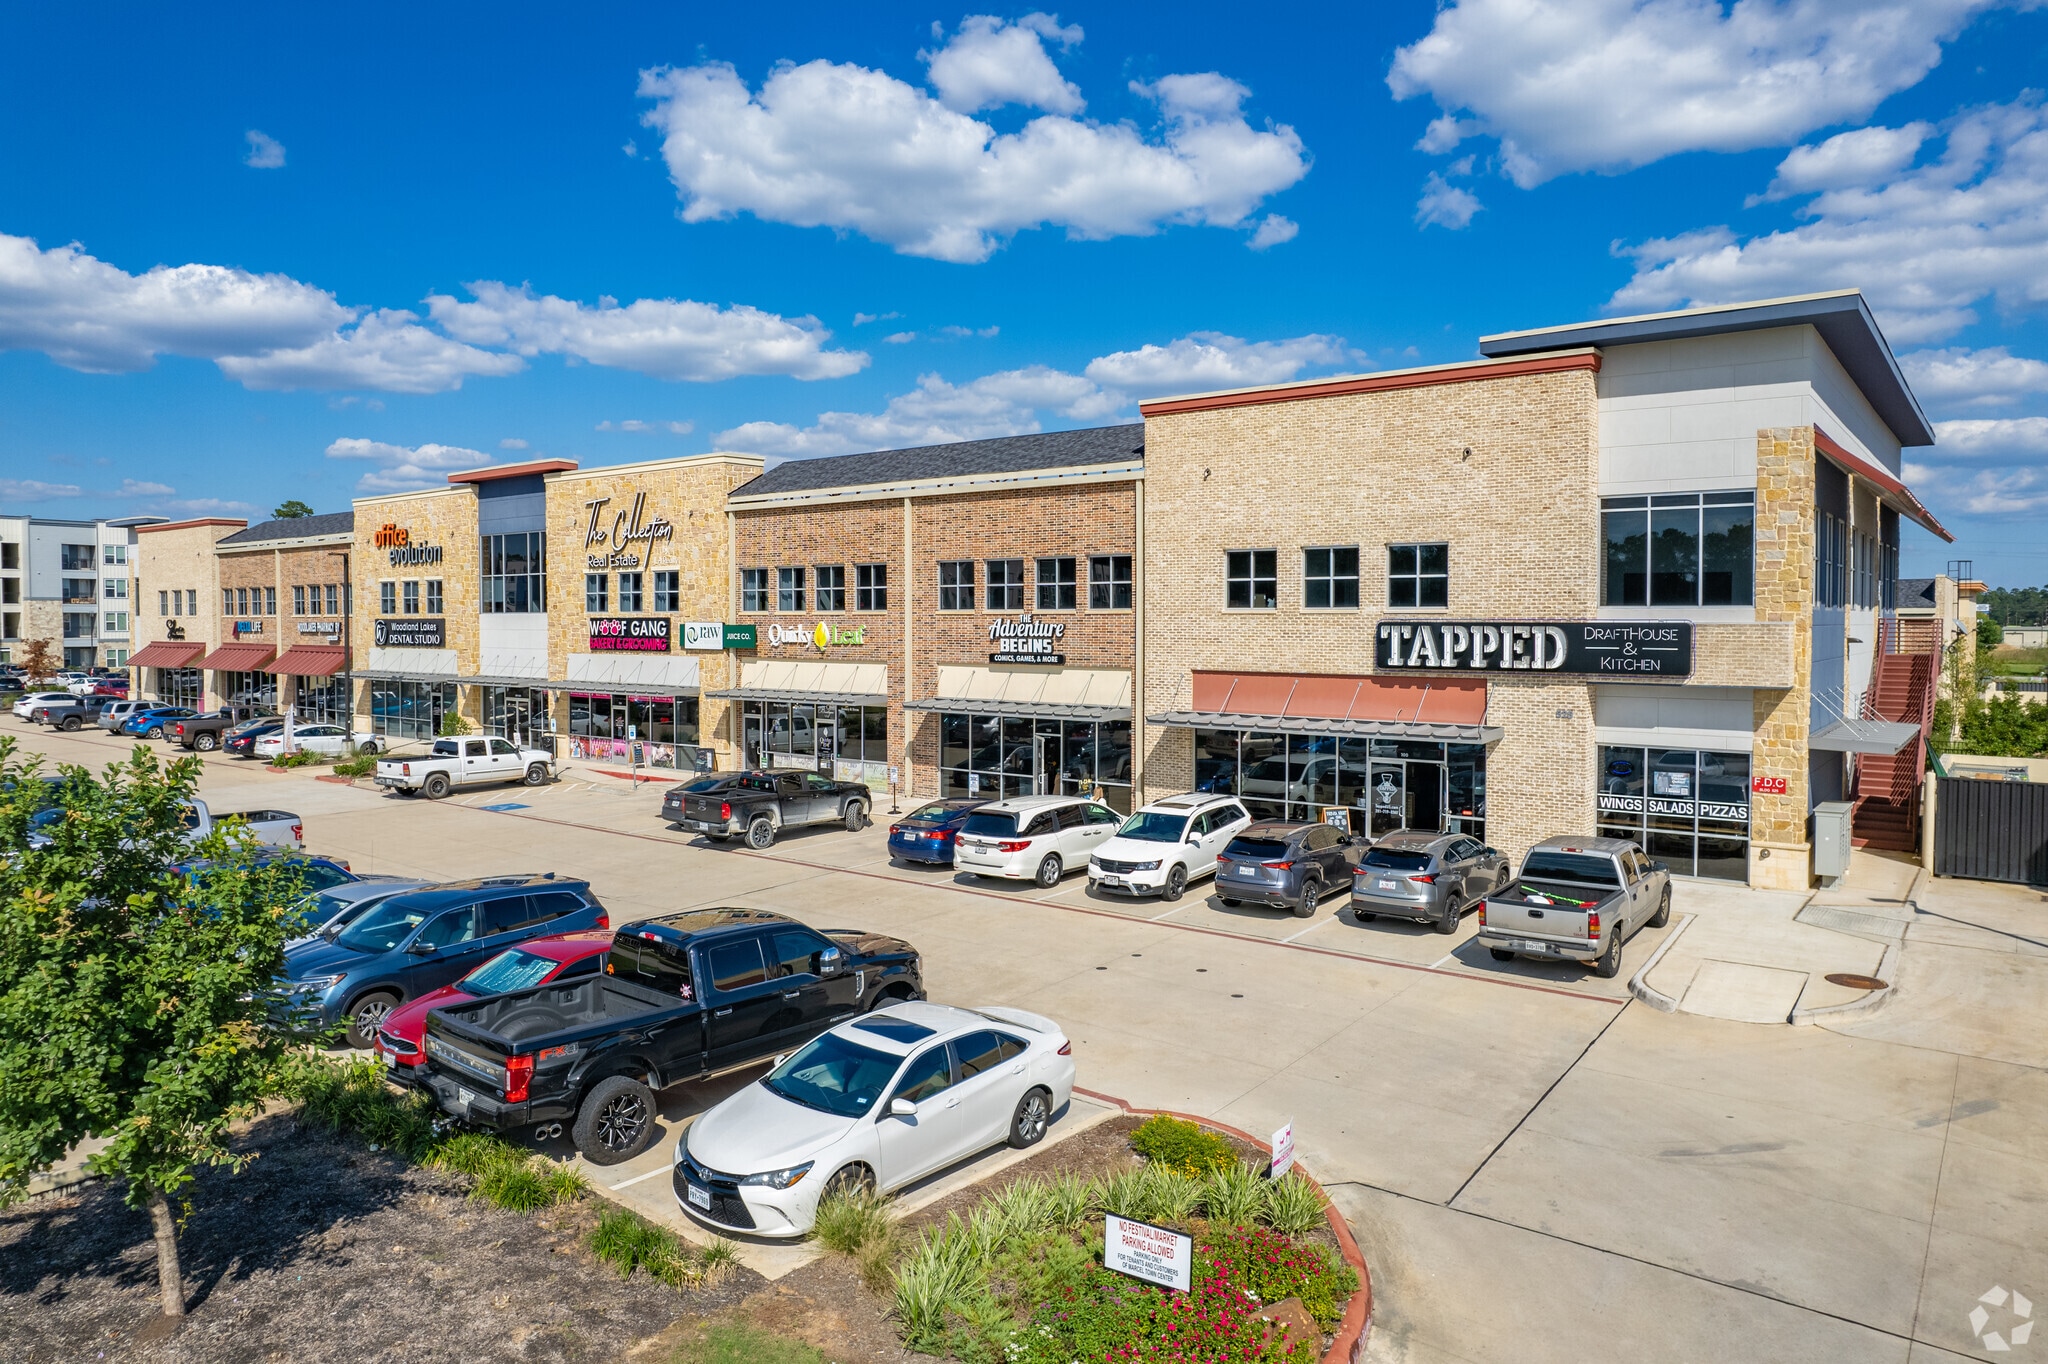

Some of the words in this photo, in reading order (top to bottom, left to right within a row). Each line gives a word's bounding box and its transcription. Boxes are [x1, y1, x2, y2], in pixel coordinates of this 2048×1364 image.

[374, 524, 407, 547] office
[583, 497, 608, 548] The
[612, 492, 671, 569] Collection
[390, 541, 441, 564] evolution
[588, 554, 606, 567] Real
[610, 554, 637, 567] Estate
[1020, 614, 1032, 623] THE
[251, 621, 262, 632] LIFE
[391, 622, 419, 631] Woodland
[420, 622, 437, 631] Lakes
[631, 620, 667, 636] GANG
[700, 626, 720, 639] raw
[989, 618, 1064, 640] Adventure
[390, 634, 414, 644] DENTAL
[414, 635, 440, 644] STUDIO
[726, 632, 741, 640] JUICE
[768, 623, 814, 649] Quirky
[831, 623, 867, 645] Leaf
[590, 637, 615, 649] BAKERY
[622, 638, 667, 651] GROOMING
[1000, 638, 1052, 653] BEGINS
[1380, 625, 1568, 670] TAPPED
[1623, 642, 1638, 656] &
[1016, 655, 1036, 663] GAMES,
[1754, 777, 1784, 788] F.D.C
[1599, 796, 1643, 811] WINGS
[1649, 800, 1694, 815] SALADS
[1700, 804, 1748, 819] PIZZAS
[539, 1041, 580, 1061] FX4
[1119, 1220, 1128, 1232] NO
[1122, 1235, 1146, 1251] PARKING
[1147, 1242, 1174, 1259] ALLOWED
[1117, 1252, 1126, 1260] FOR
[1126, 1255, 1145, 1266] TENANTS
[1145, 1261, 1154, 1269] AND
[1154, 1263, 1179, 1277] CUSTOMERS
[1133, 1250, 1151, 1261] PARKING
[1152, 1255, 1162, 1264] ONLY
[1128, 1263, 1144, 1274] MARCEL
[1145, 1268, 1157, 1278] TOWN
[1157, 1272, 1174, 1282] CENTER
